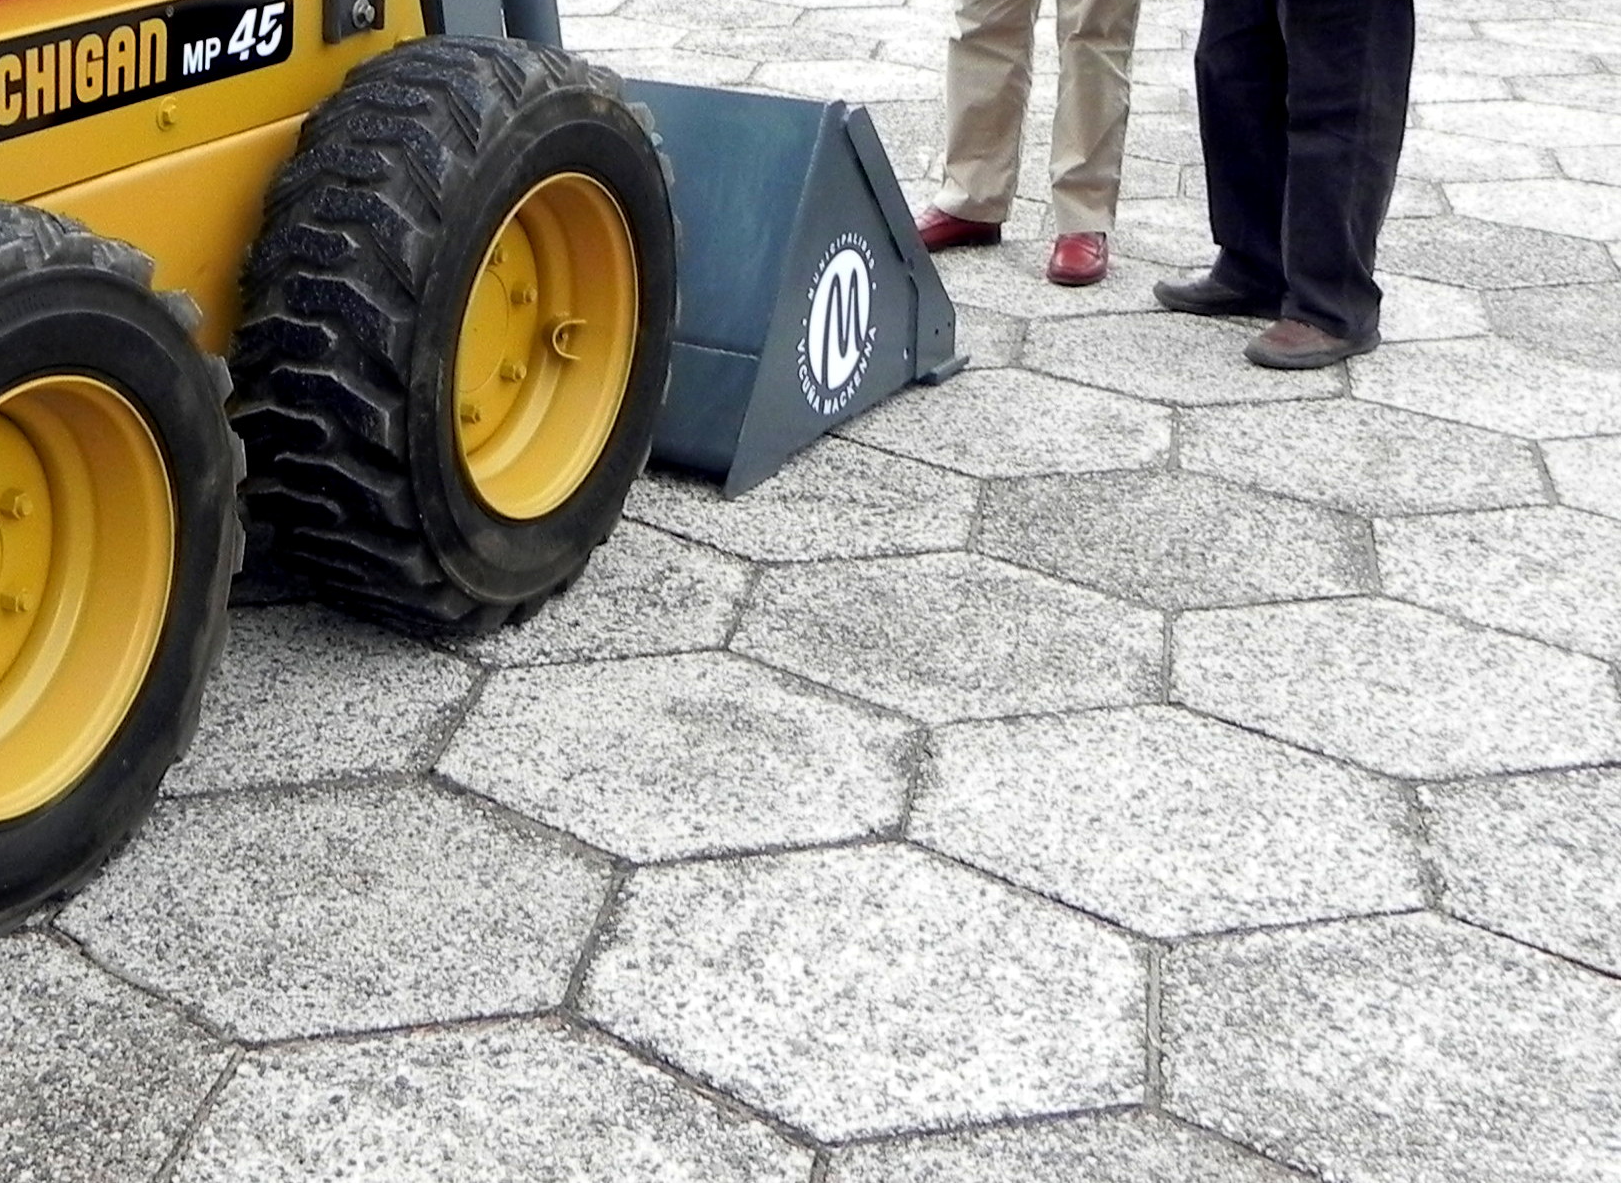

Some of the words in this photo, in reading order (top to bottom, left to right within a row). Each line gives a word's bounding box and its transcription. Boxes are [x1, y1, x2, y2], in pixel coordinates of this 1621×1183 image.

[182, 37, 222, 76] MP
[227, 2, 286, 61] 45
[807, 232, 875, 301] MUNICIPALIDAD
[823, 327, 877, 415] MACKENNA
